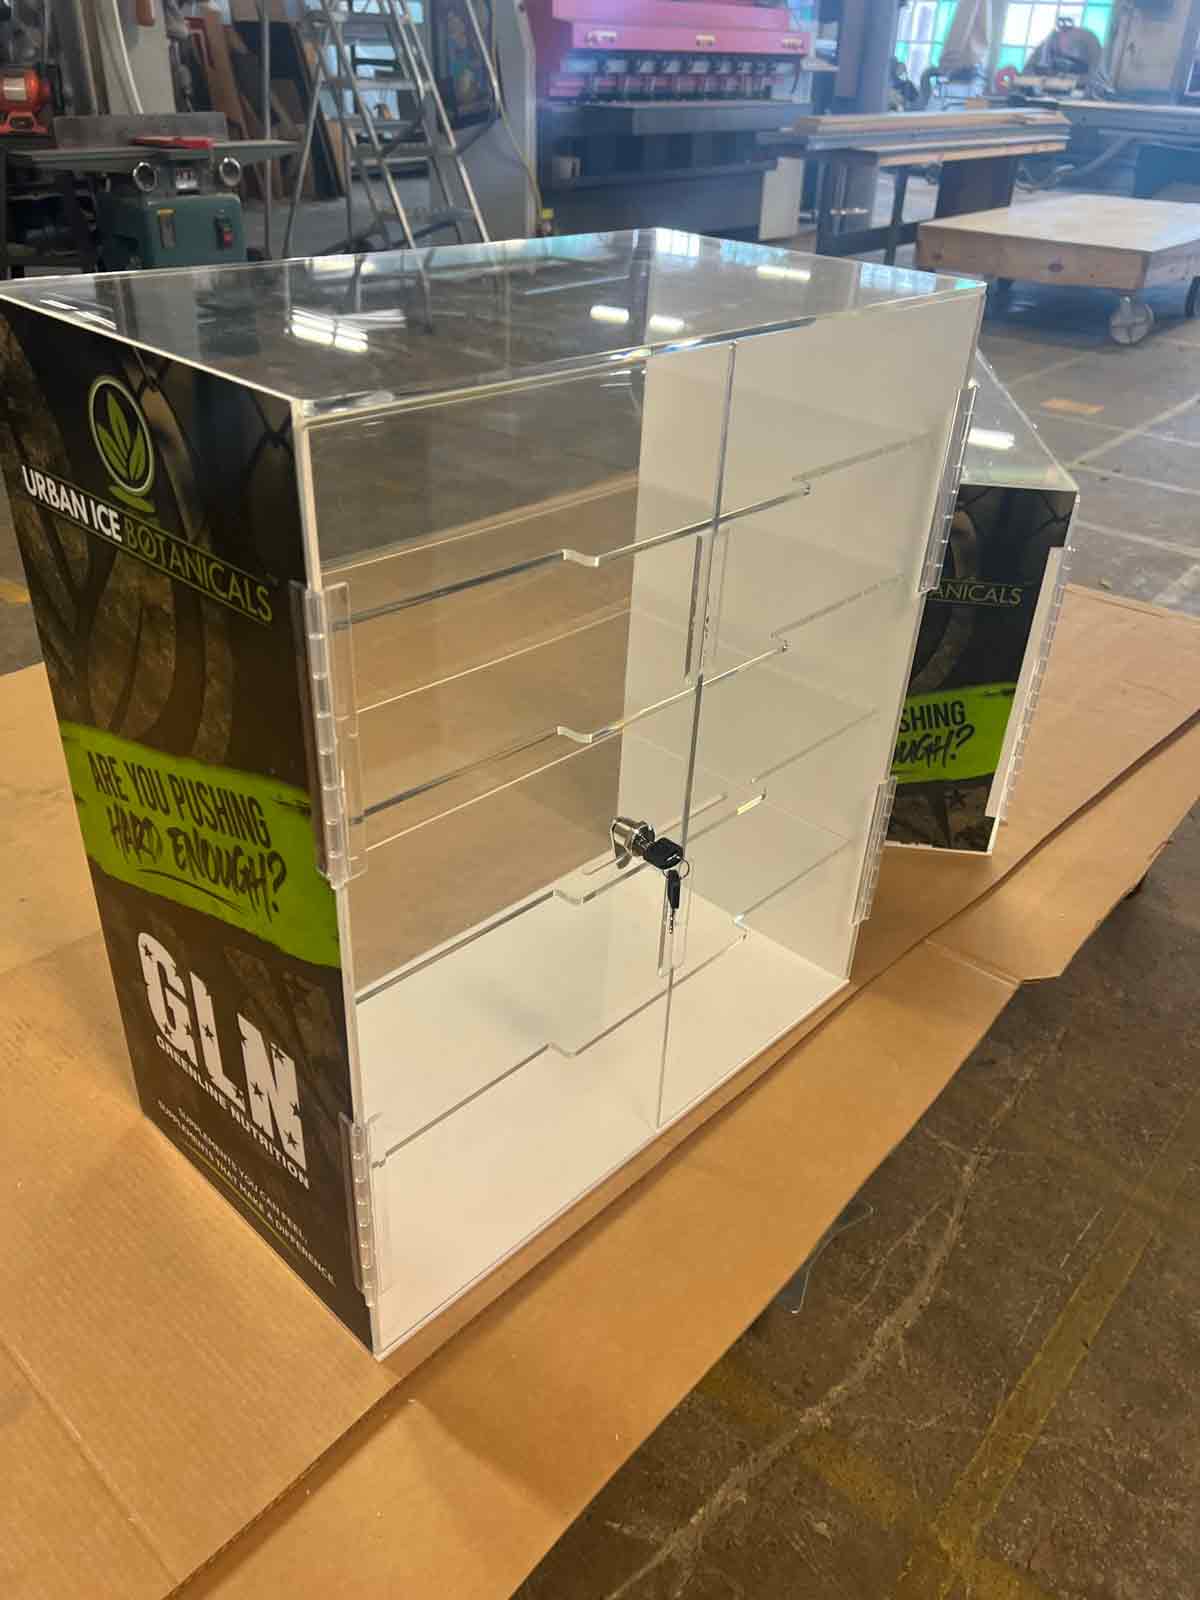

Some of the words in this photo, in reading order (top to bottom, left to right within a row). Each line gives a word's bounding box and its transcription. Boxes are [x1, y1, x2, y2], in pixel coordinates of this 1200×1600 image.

[22, 464, 89, 524] URBAN
[89, 499, 123, 542] ICE
[124, 516, 273, 622] BOTANICALS
[927, 583, 1023, 605] ANICALS
[899, 699, 966, 733] SHING
[87, 751, 129, 802] ARE
[124, 760, 170, 816] YOU
[167, 773, 271, 849] PUSHING
[106, 803, 163, 864] HARD
[165, 825, 287, 923] ENOUGH?
[137, 931, 307, 1171] GLN
[155, 1034, 228, 1110] GREENLINE
[230, 1104, 310, 1190] NUTRITION
